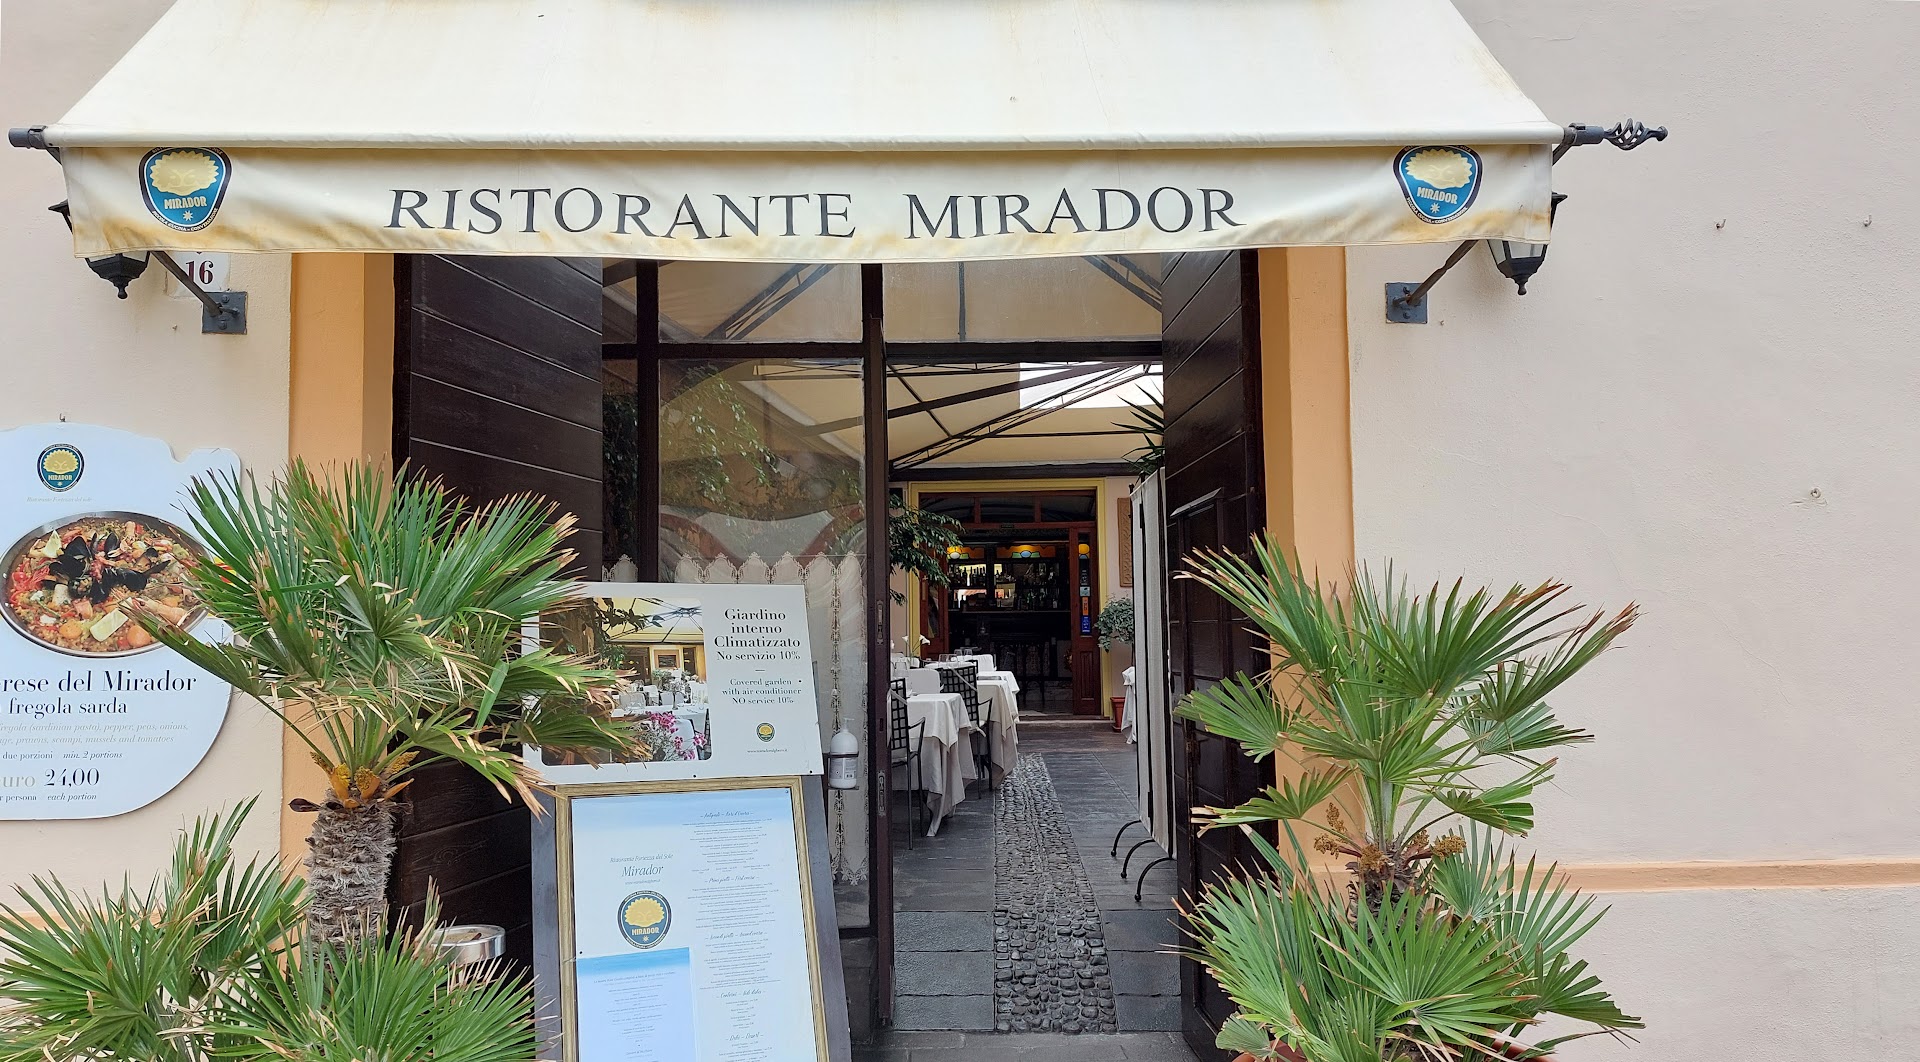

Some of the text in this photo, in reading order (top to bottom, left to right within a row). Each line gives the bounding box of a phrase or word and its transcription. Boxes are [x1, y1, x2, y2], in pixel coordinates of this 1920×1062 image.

[1417, 187, 1458, 204] MIRADOR
[164, 196, 207, 209] MIRADOR
[384, 186, 1247, 240] RISTORANTE MIRADOR
[185, 260, 214, 285] 16
[724, 608, 786, 620] Giardino
[731, 622, 783, 634] interno
[714, 635, 801, 648] Climatizzato
[716, 650, 801, 661] No servizio 10%
[0, 669, 197, 692] rese del Mirador
[730, 677, 792, 687] Covered garden
[742, 687, 754, 695] air
[755, 687, 801, 695] conditioner
[748, 696, 775, 704] service
[8, 696, 128, 720] fregola sarda
[118, 735, 136, 743] and
[2, 750, 18, 760] due
[20, 750, 53, 761] porzioni
[82, 751, 89, 759] 2
[89, 750, 123, 761] portions
[43, 767, 100, 788] 24,00
[5, 795, 37, 803] persona
[47, 793, 66, 801] each
[67, 792, 97, 802] portion
[621, 864, 664, 877] Mirador
[631, 926, 660, 936] MIRADOR
